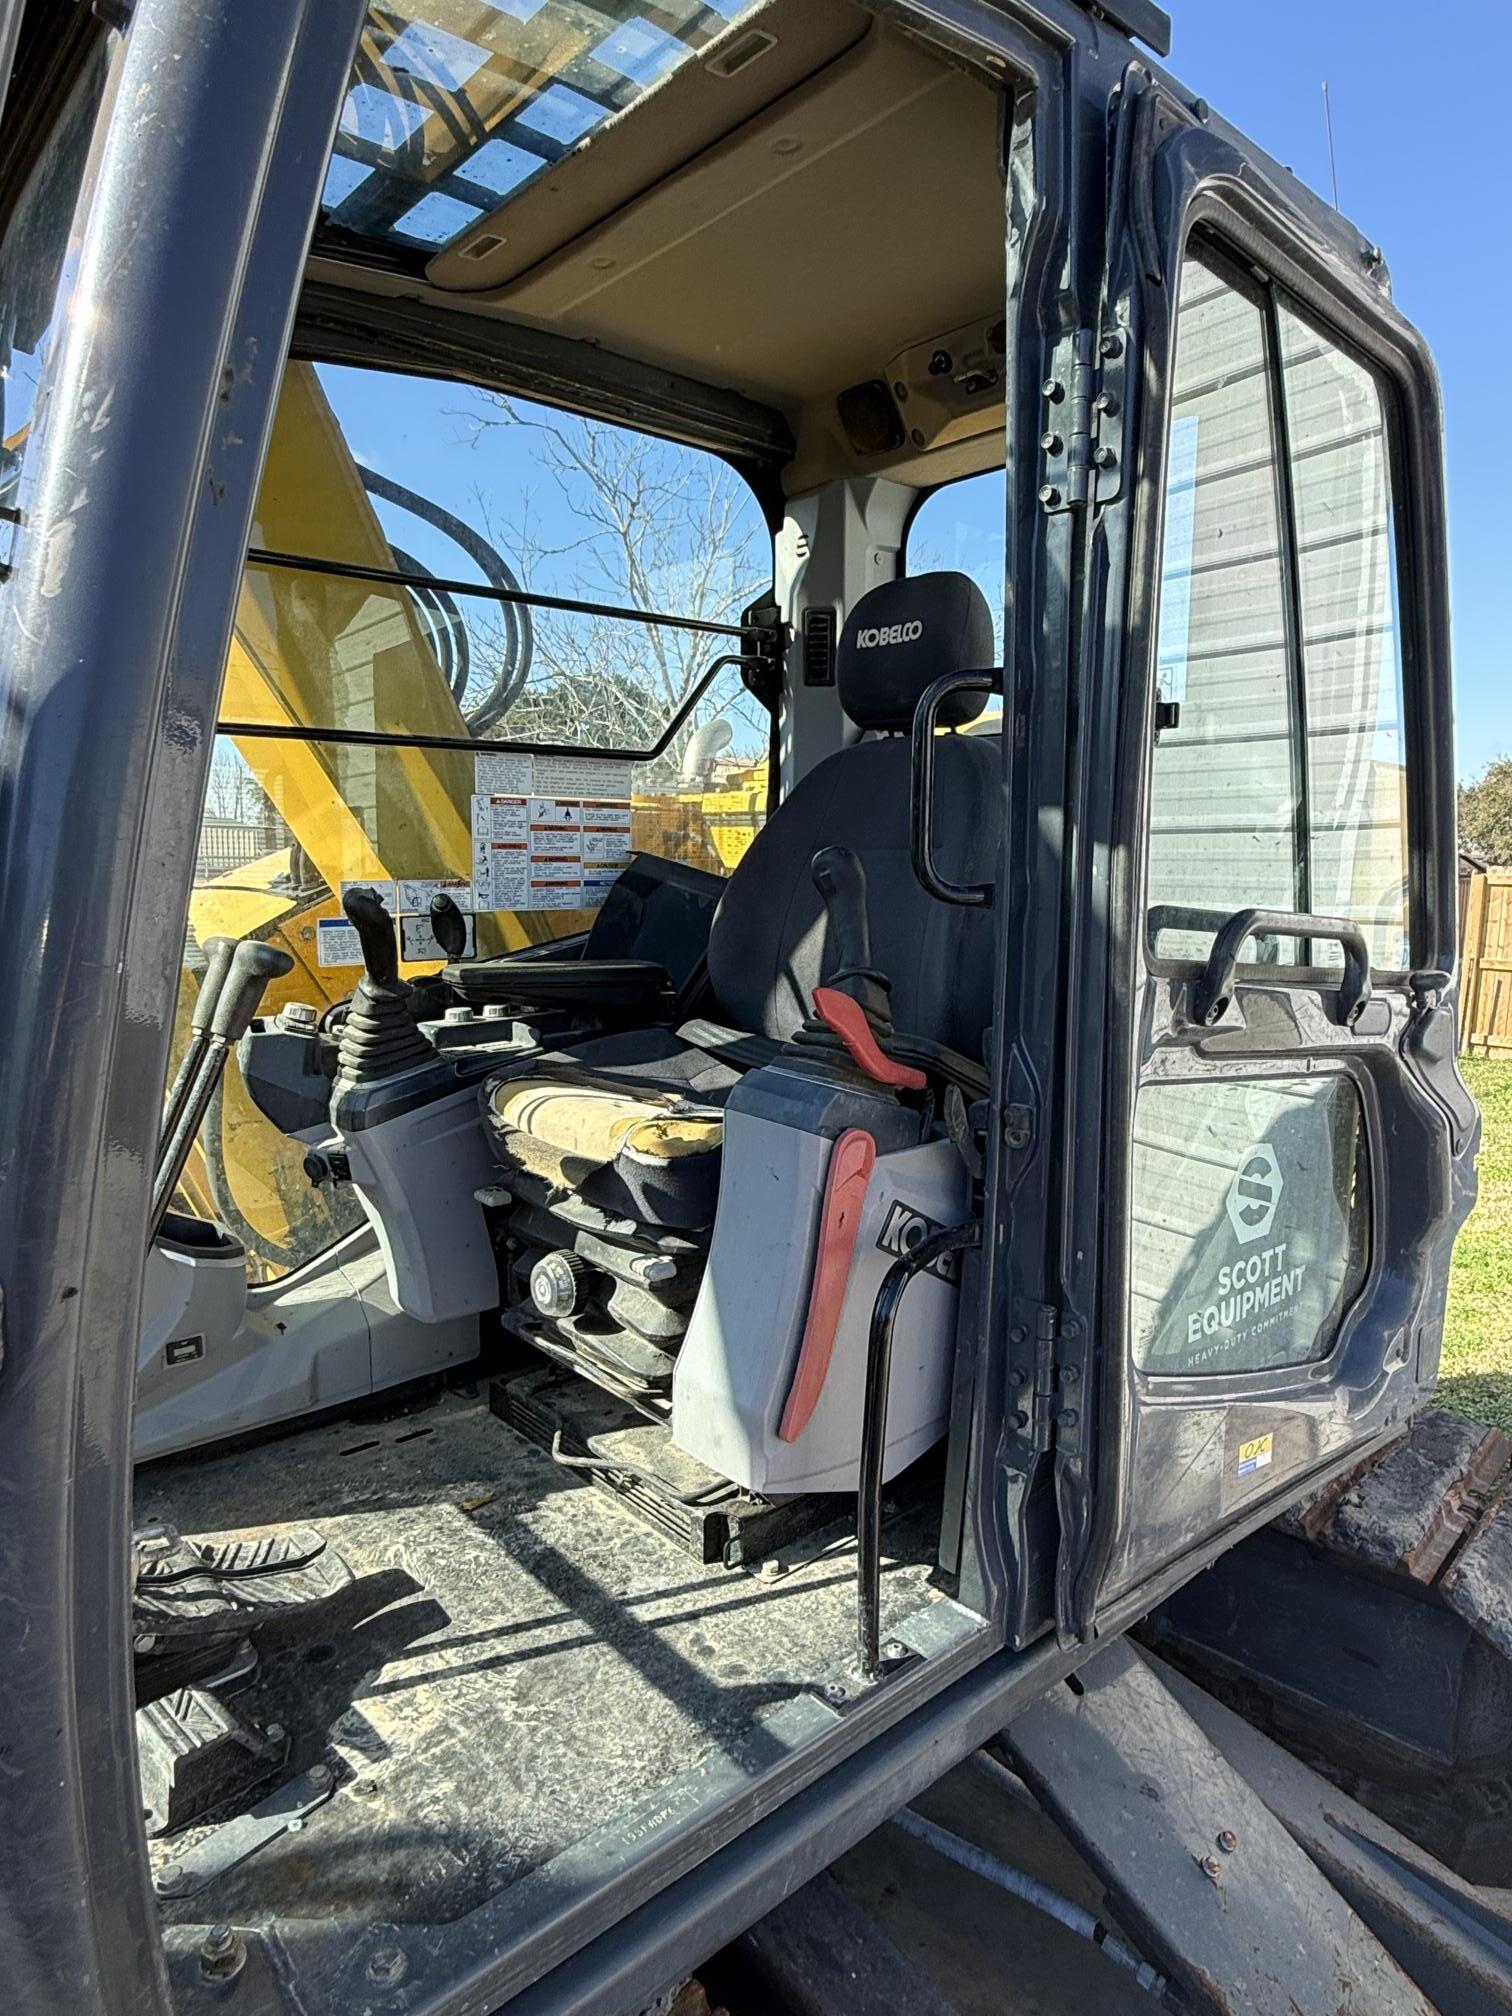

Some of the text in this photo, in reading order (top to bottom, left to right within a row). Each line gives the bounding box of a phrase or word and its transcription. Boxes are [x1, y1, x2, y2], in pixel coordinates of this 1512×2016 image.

[856, 620, 923, 649] KOBELCO
[1218, 1243, 1287, 1296] SCOTT
[1187, 1264, 1307, 1344] EQUIPMENT
[1188, 1328, 1248, 1368] HEAVY-DUTY
[1251, 1302, 1304, 1337] COMMITMENT
